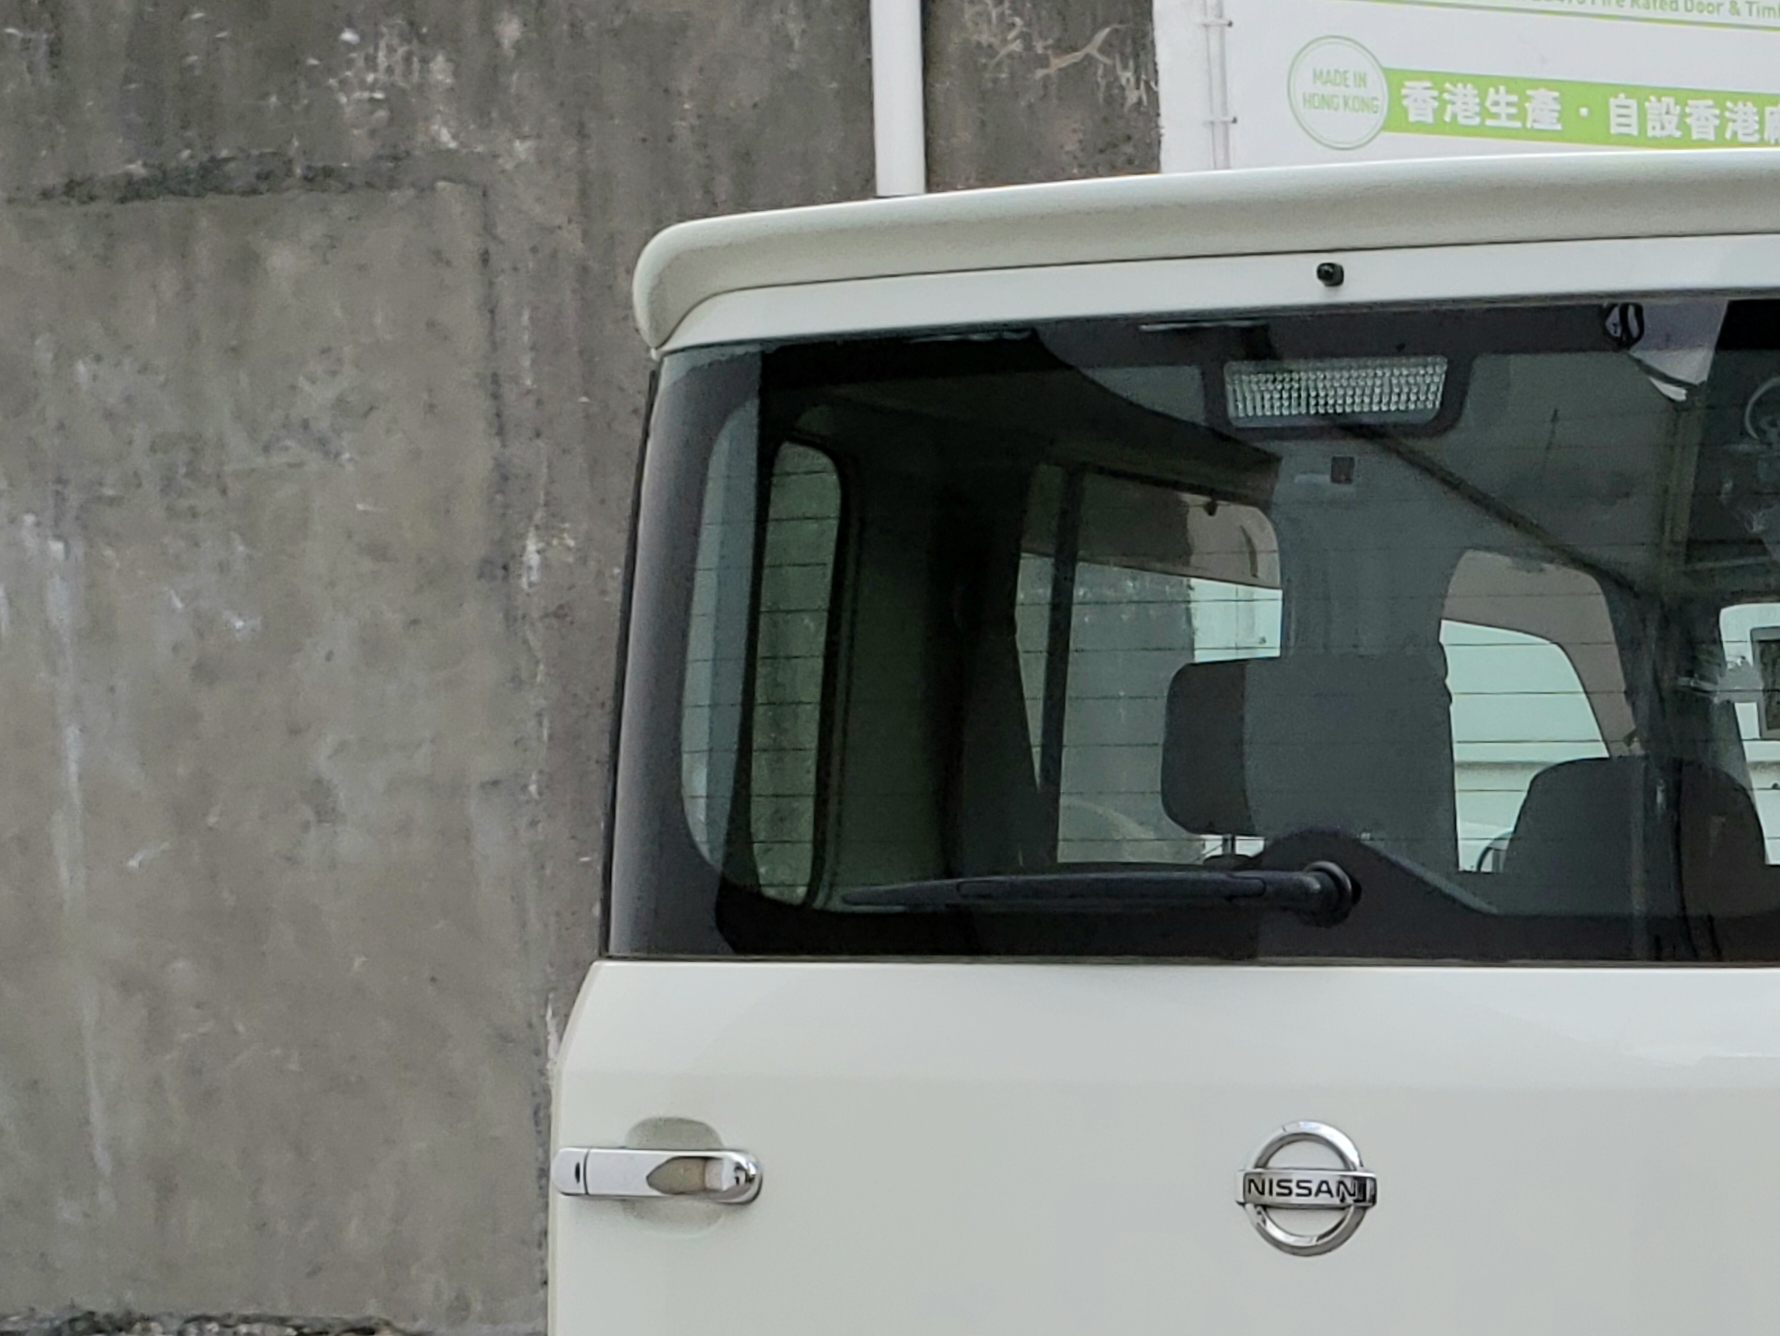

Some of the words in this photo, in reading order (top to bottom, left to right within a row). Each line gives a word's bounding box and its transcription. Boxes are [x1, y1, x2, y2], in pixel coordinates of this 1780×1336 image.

[1684, 0, 1724, 16] Door
[1728, 0, 1741, 17] &
[1312, 67, 1351, 88] MADE
[1353, 70, 1368, 89] IN
[1302, 91, 1340, 112] HONG
[1344, 93, 1379, 114] KONG
[1247, 1177, 1357, 1199] NISSAN
